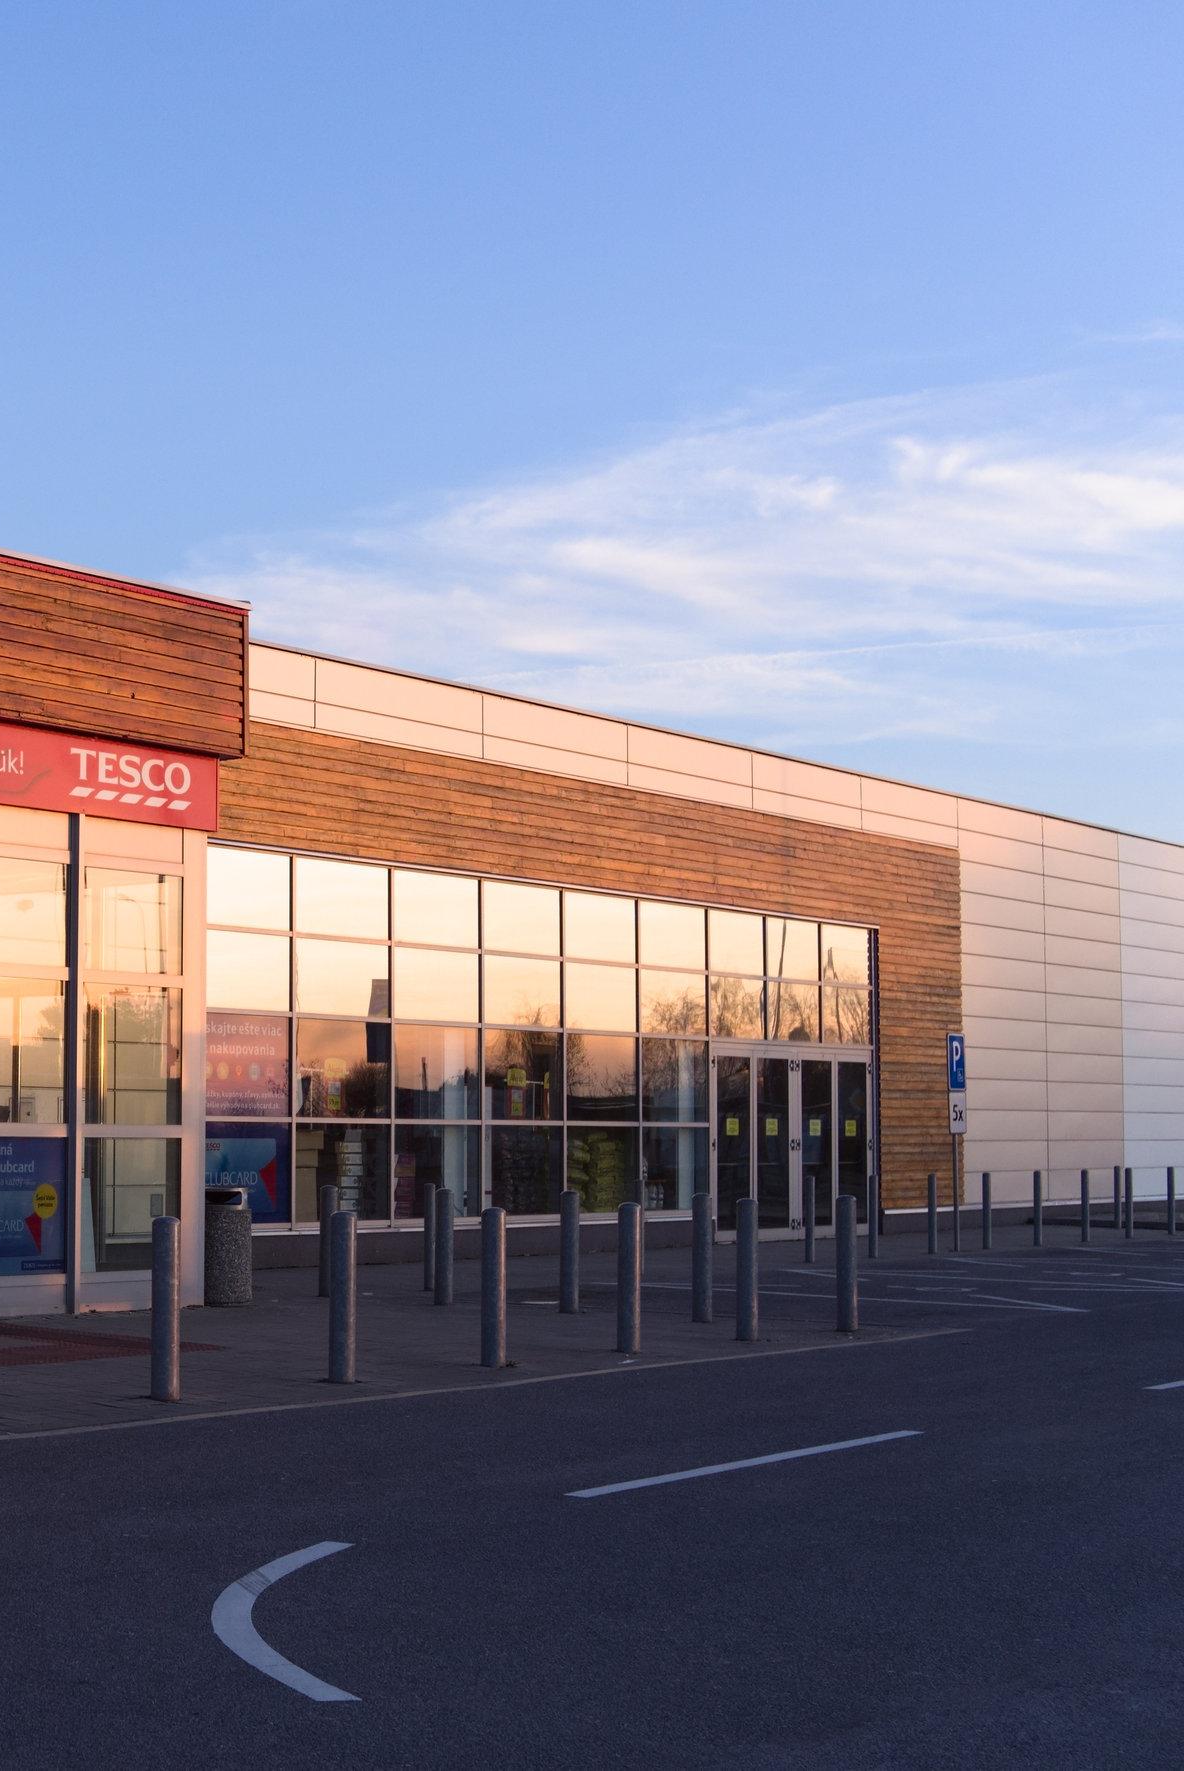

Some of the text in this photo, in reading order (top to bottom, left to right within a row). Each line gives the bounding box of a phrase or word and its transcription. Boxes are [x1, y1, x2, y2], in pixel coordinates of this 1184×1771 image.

[70, 747, 191, 795] TESCO
[206, 1021, 282, 1037] skajte ešte viac
[210, 1042, 275, 1058] nakupovania
[952, 1041, 961, 1072] P
[952, 1104, 964, 1121] 5x
